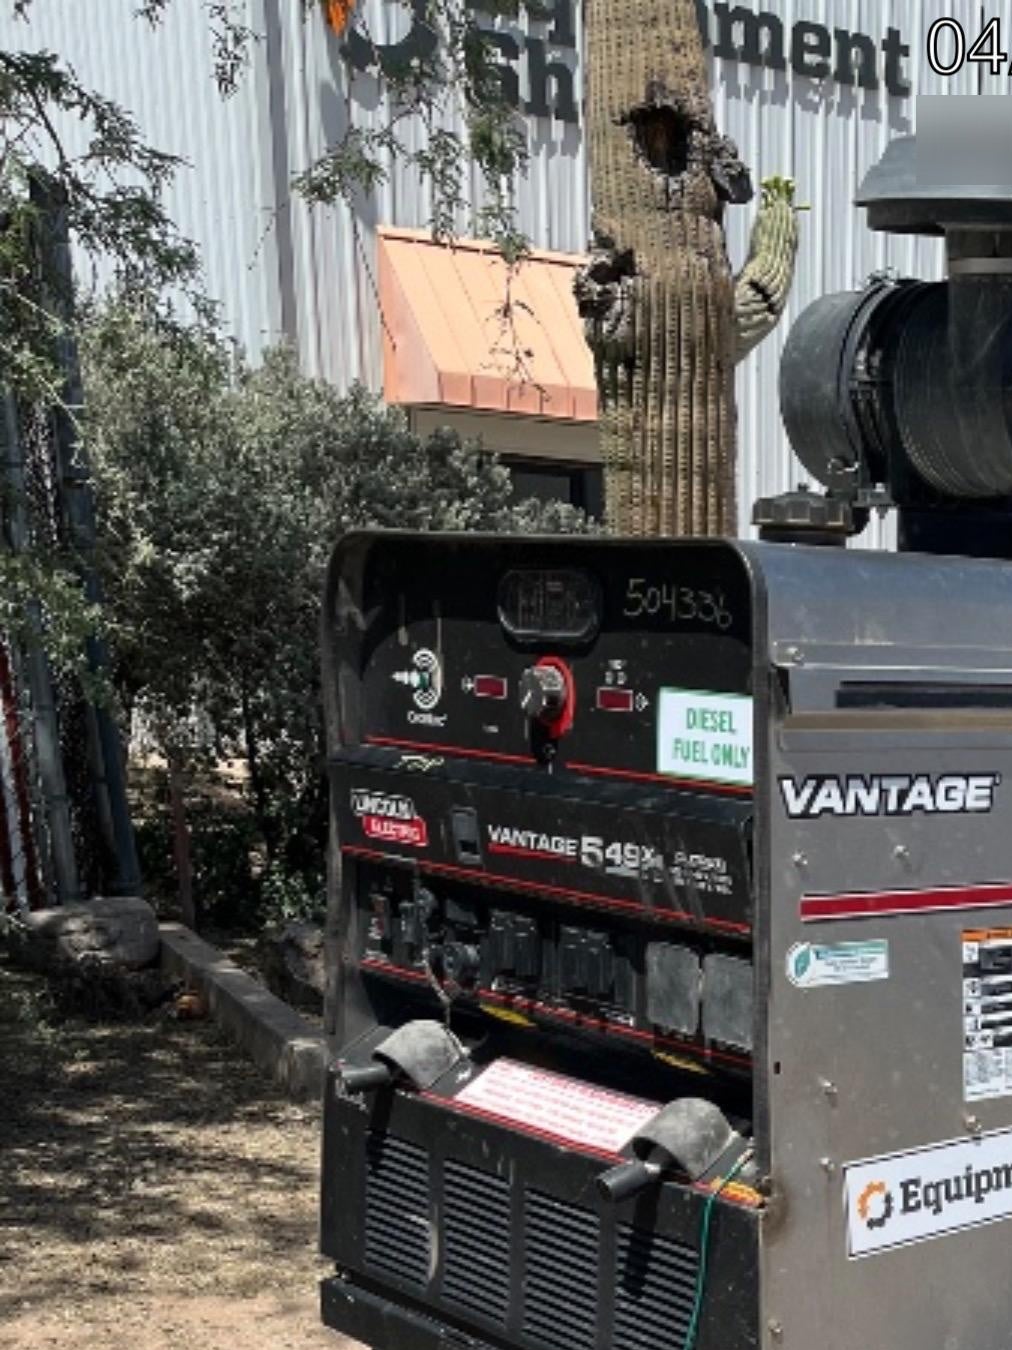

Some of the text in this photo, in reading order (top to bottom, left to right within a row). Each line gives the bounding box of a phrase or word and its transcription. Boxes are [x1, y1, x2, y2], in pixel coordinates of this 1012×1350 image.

[623, 577, 733, 629] 504336
[686, 706, 737, 734] DIESEL
[672, 737, 751, 769] FUEL ONLY
[778, 774, 995, 818] VANTAGE
[488, 824, 579, 856] VANTAGE
